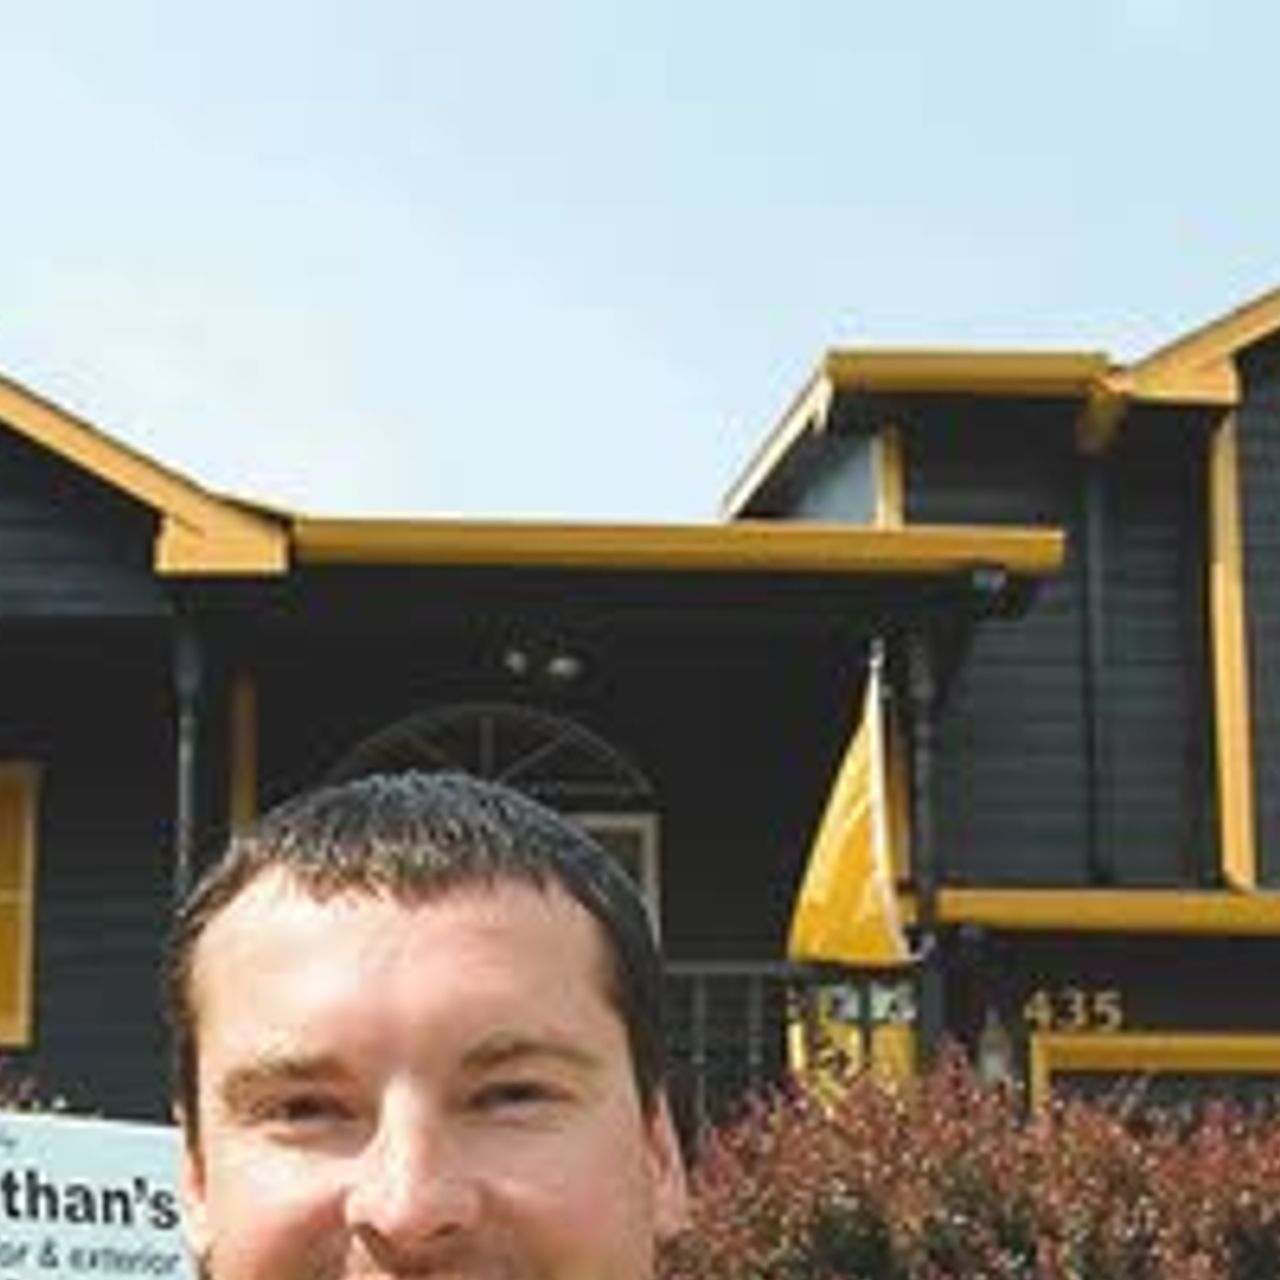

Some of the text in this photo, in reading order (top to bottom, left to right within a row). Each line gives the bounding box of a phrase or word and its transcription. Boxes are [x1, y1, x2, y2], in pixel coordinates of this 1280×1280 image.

[1023, 990, 1122, 1031] 435
[38, 1237, 60, 1268] &
[70, 1246, 181, 1276] exterior
